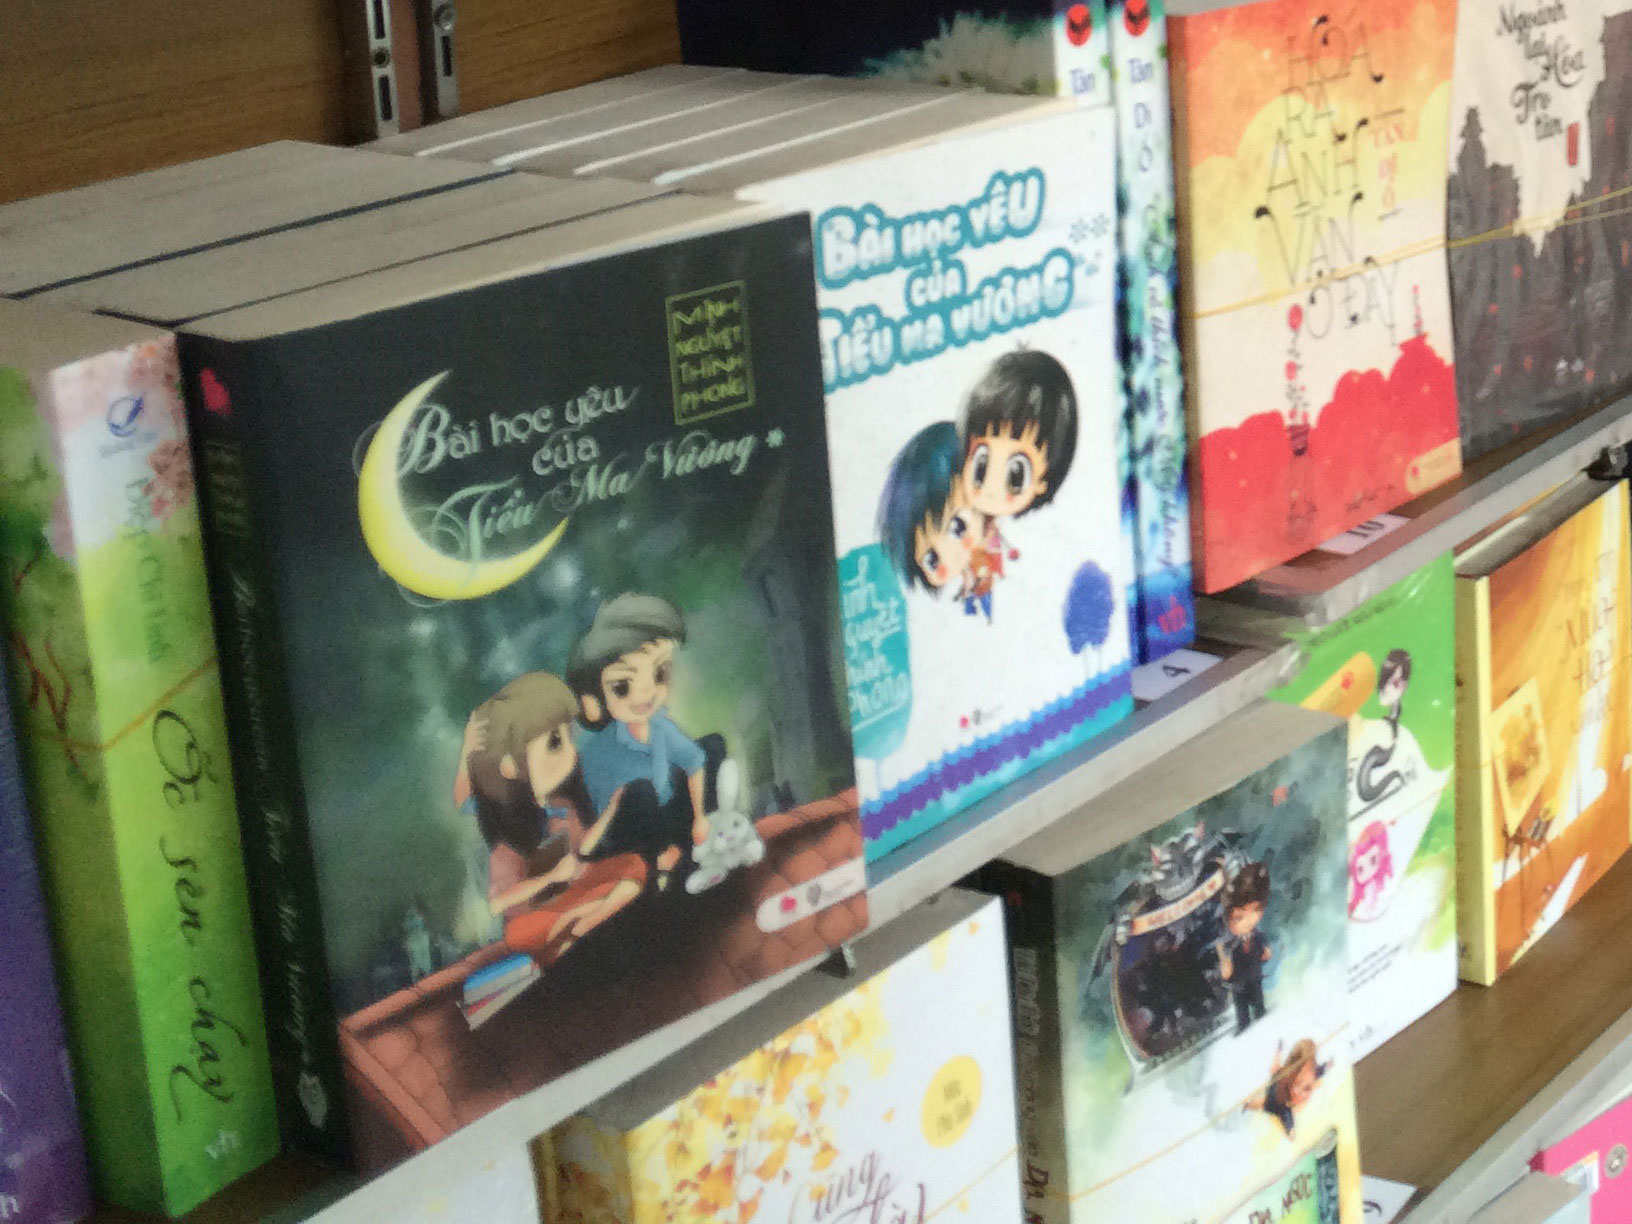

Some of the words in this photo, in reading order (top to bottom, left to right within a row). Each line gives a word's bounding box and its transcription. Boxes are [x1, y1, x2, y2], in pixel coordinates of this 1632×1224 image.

[489, 410, 554, 444] học
[564, 382, 641, 425] yêu
[531, 425, 600, 476] của
